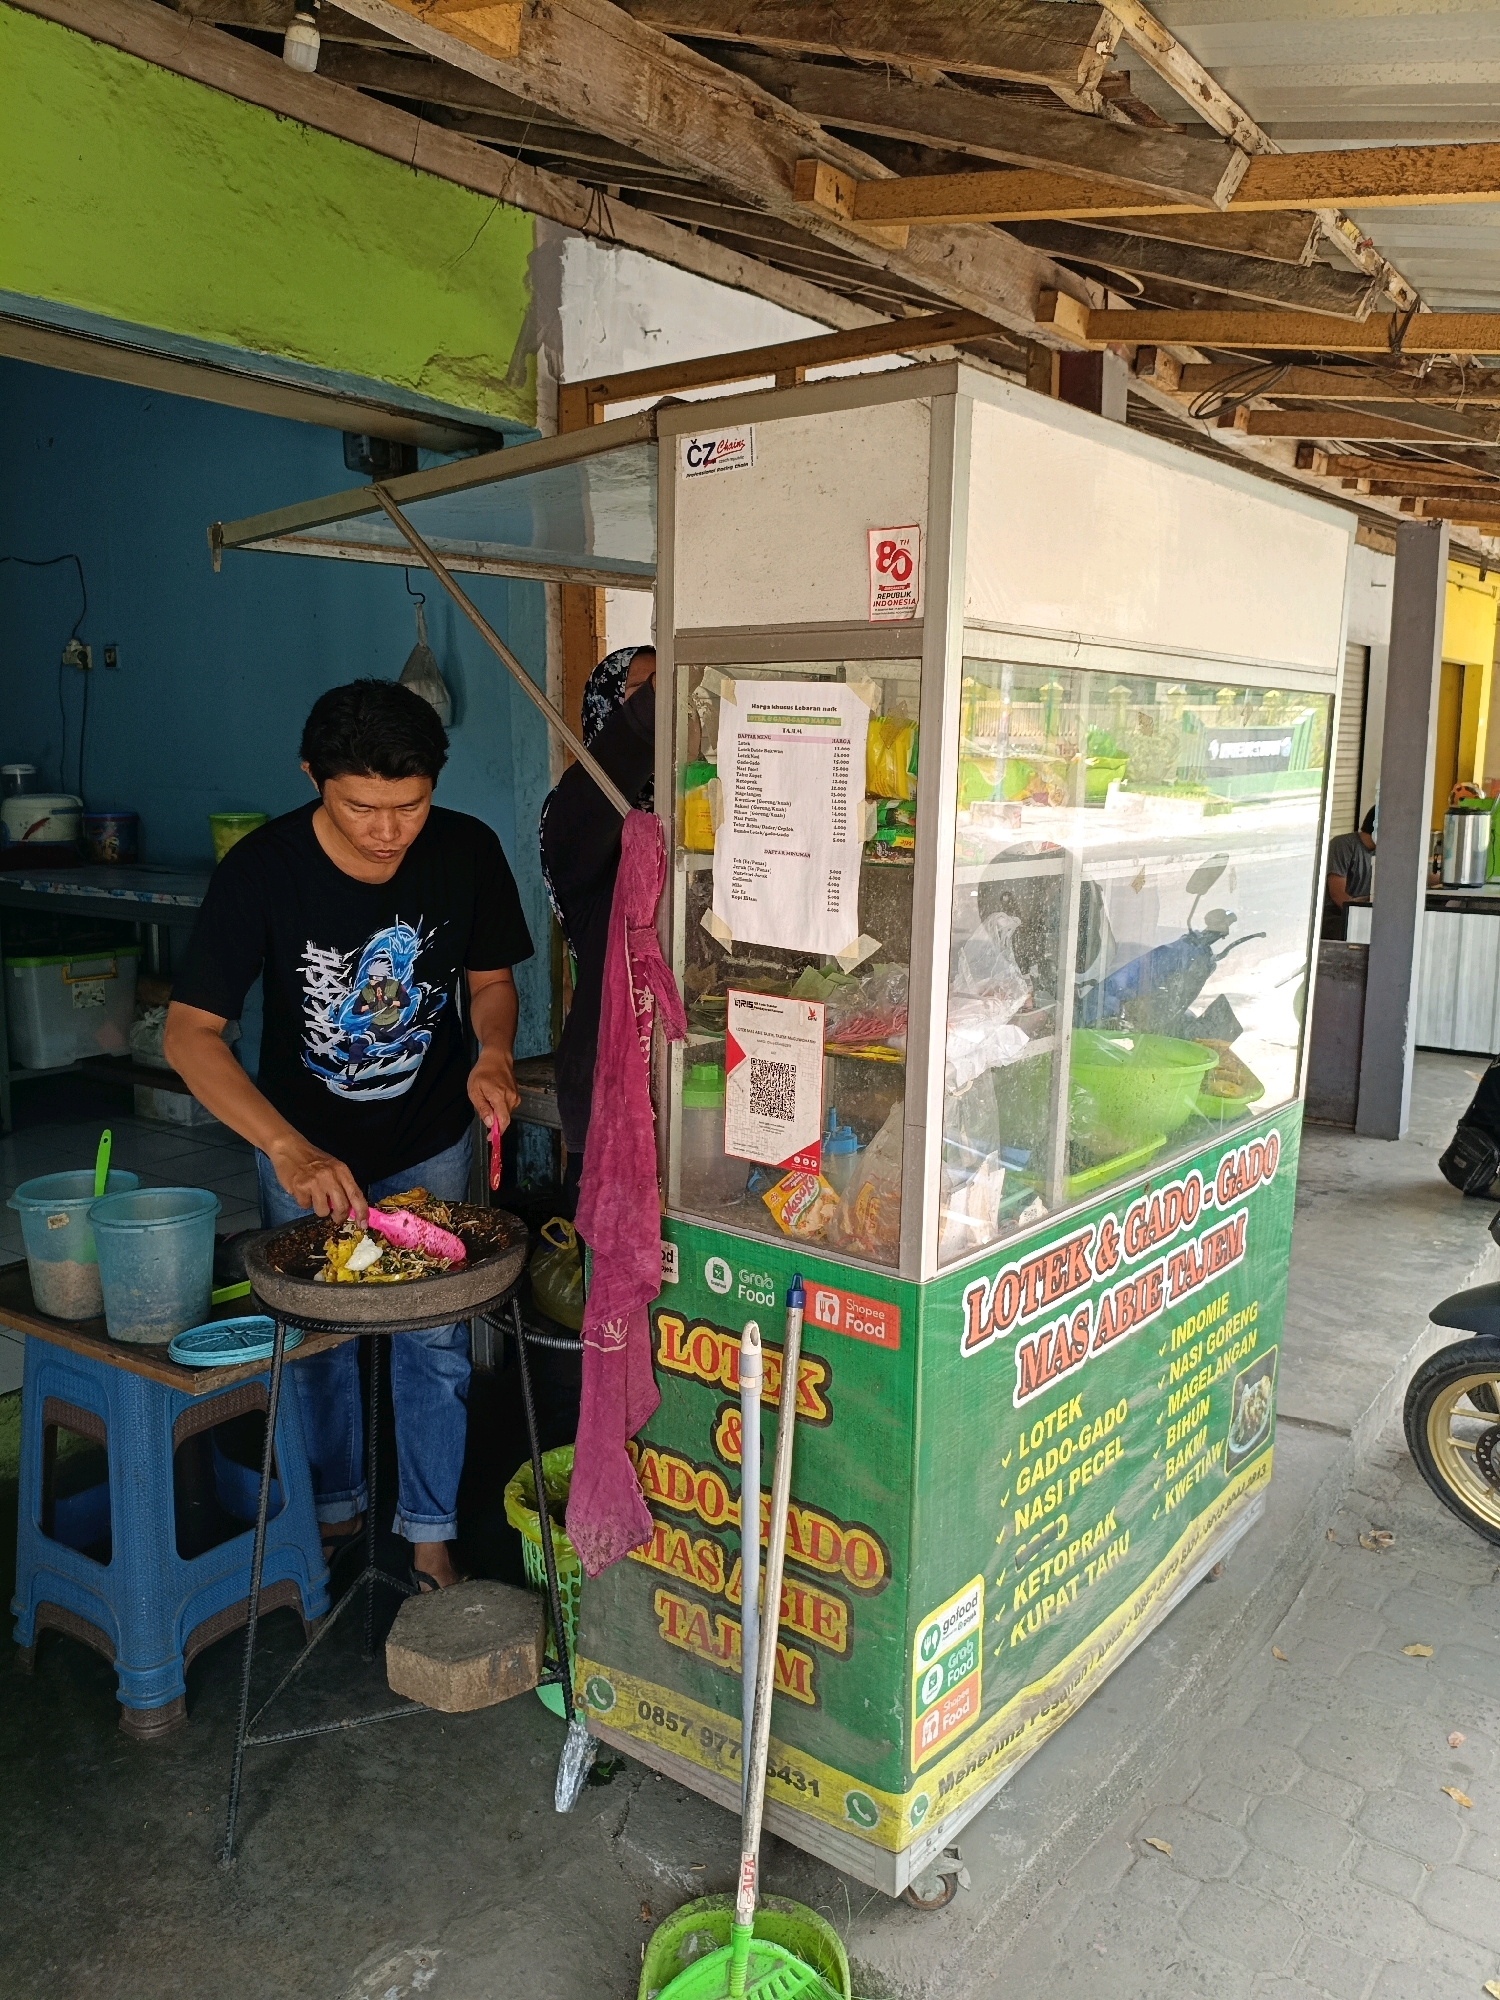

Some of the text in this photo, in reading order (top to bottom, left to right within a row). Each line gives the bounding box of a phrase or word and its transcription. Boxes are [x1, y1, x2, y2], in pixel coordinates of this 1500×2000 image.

[687, 438, 716, 468] ČZ
[876, 540, 913, 581] 80
[873, 598, 916, 607] INDONESIA
[877, 591, 912, 600] REPUBLIK
[751, 703, 770, 711] Harga
[771, 703, 794, 711] khusus
[772, 715, 810, 724] GADO-GADO
[734, 999, 754, 1011] QRIS
[738, 1269, 774, 1290] Grab
[738, 1283, 775, 1308] Food
[965, 1231, 1092, 1351] LOTEK
[1094, 1218, 1120, 1277] &
[845, 1298, 885, 1320] Shopee
[845, 1312, 885, 1340] Food
[1017, 1214, 1247, 1401] MAS ABIE TAJEM
[1171, 1290, 1230, 1352] INDOMIE
[663, 1321, 821, 1413] LOTEK
[1169, 1300, 1258, 1385] NASI GORENG
[1167, 1327, 1258, 1418] MAGELANGAN
[1016, 1398, 1129, 1496] GADO-GADO
[1019, 1392, 1084, 1460] LOTEK
[1166, 1394, 1211, 1451] BIHUN
[1165, 1437, 1226, 1515] KWETIAW
[1166, 1424, 1209, 1482] BAKMI
[1015, 1436, 1125, 1537] NASI PECEL
[1013, 1504, 1117, 1612] KETOPRAK
[942, 1591, 979, 1635] gofood
[1010, 1572, 1080, 1648] KUPAT
[1083, 1528, 1130, 1589] TAHU
[659, 1596, 810, 1698] TAJM
[947, 1639, 974, 1669] Grab
[947, 1652, 974, 1687] Food
[637, 1700, 694, 1738] 0857
[699, 1726, 743, 1760] 977
[942, 1700, 971, 1730] Food
[741, 1858, 756, 1904] ALFA
